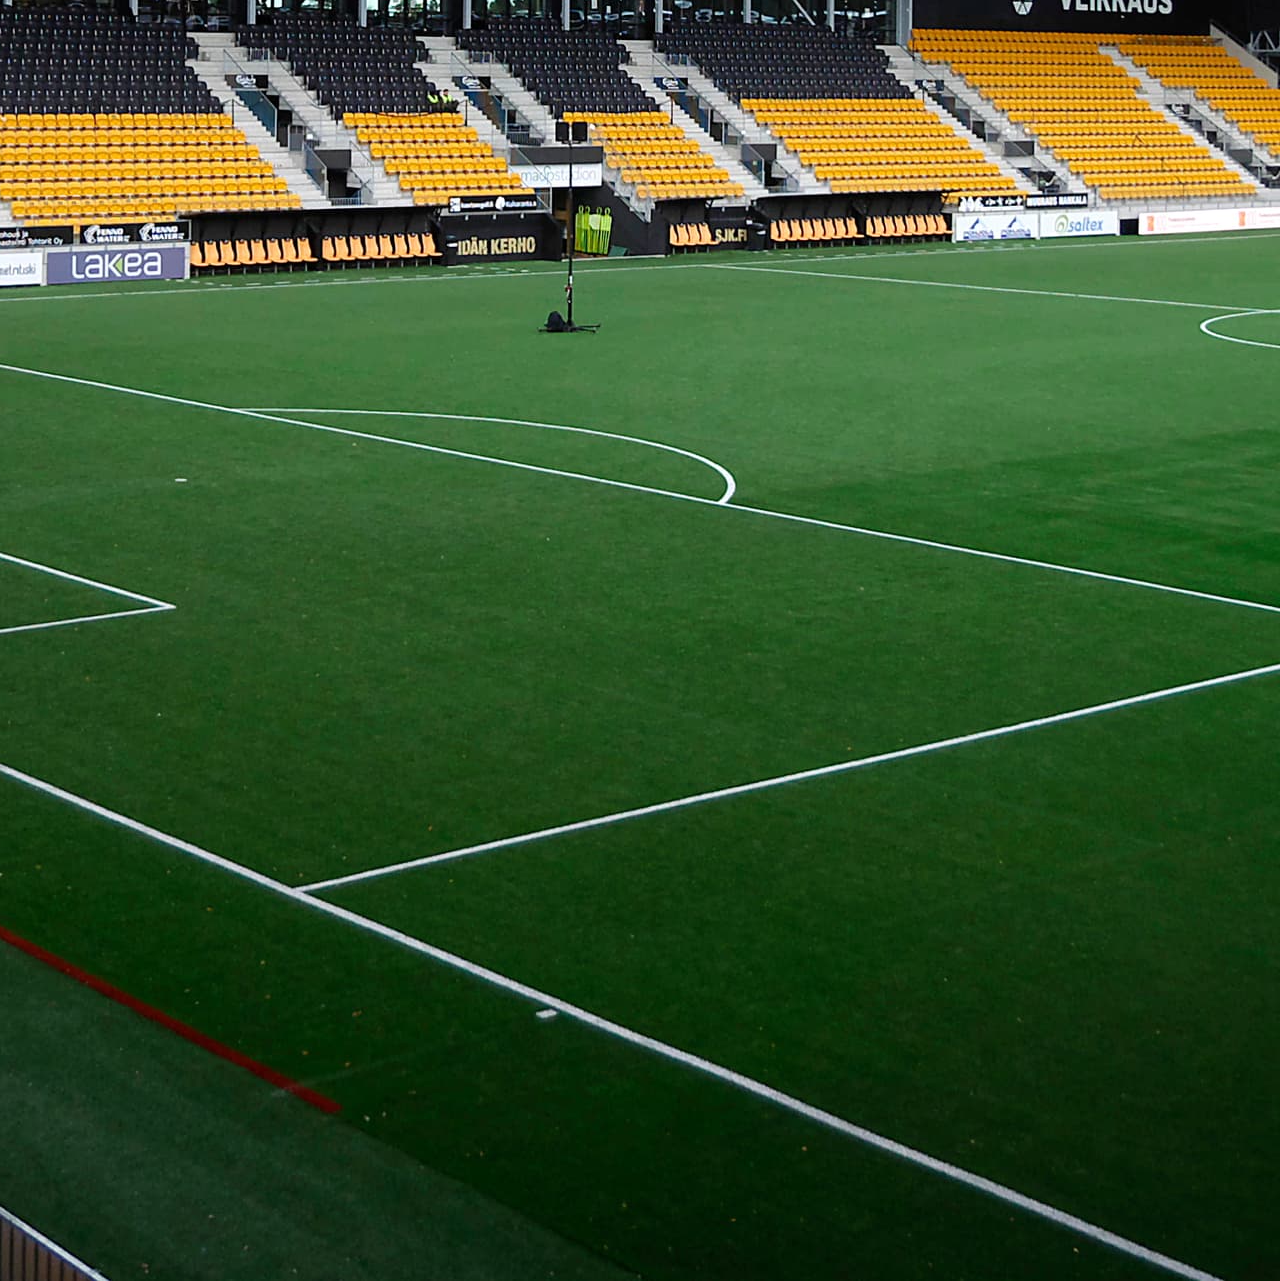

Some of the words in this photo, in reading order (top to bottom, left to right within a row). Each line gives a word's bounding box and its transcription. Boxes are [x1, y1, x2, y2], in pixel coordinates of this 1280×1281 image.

[1067, 217, 1104, 233] saltex
[53, 237, 63, 246] Oy
[715, 228, 748, 243] SJK.FI
[490, 236, 536, 255] KERHO
